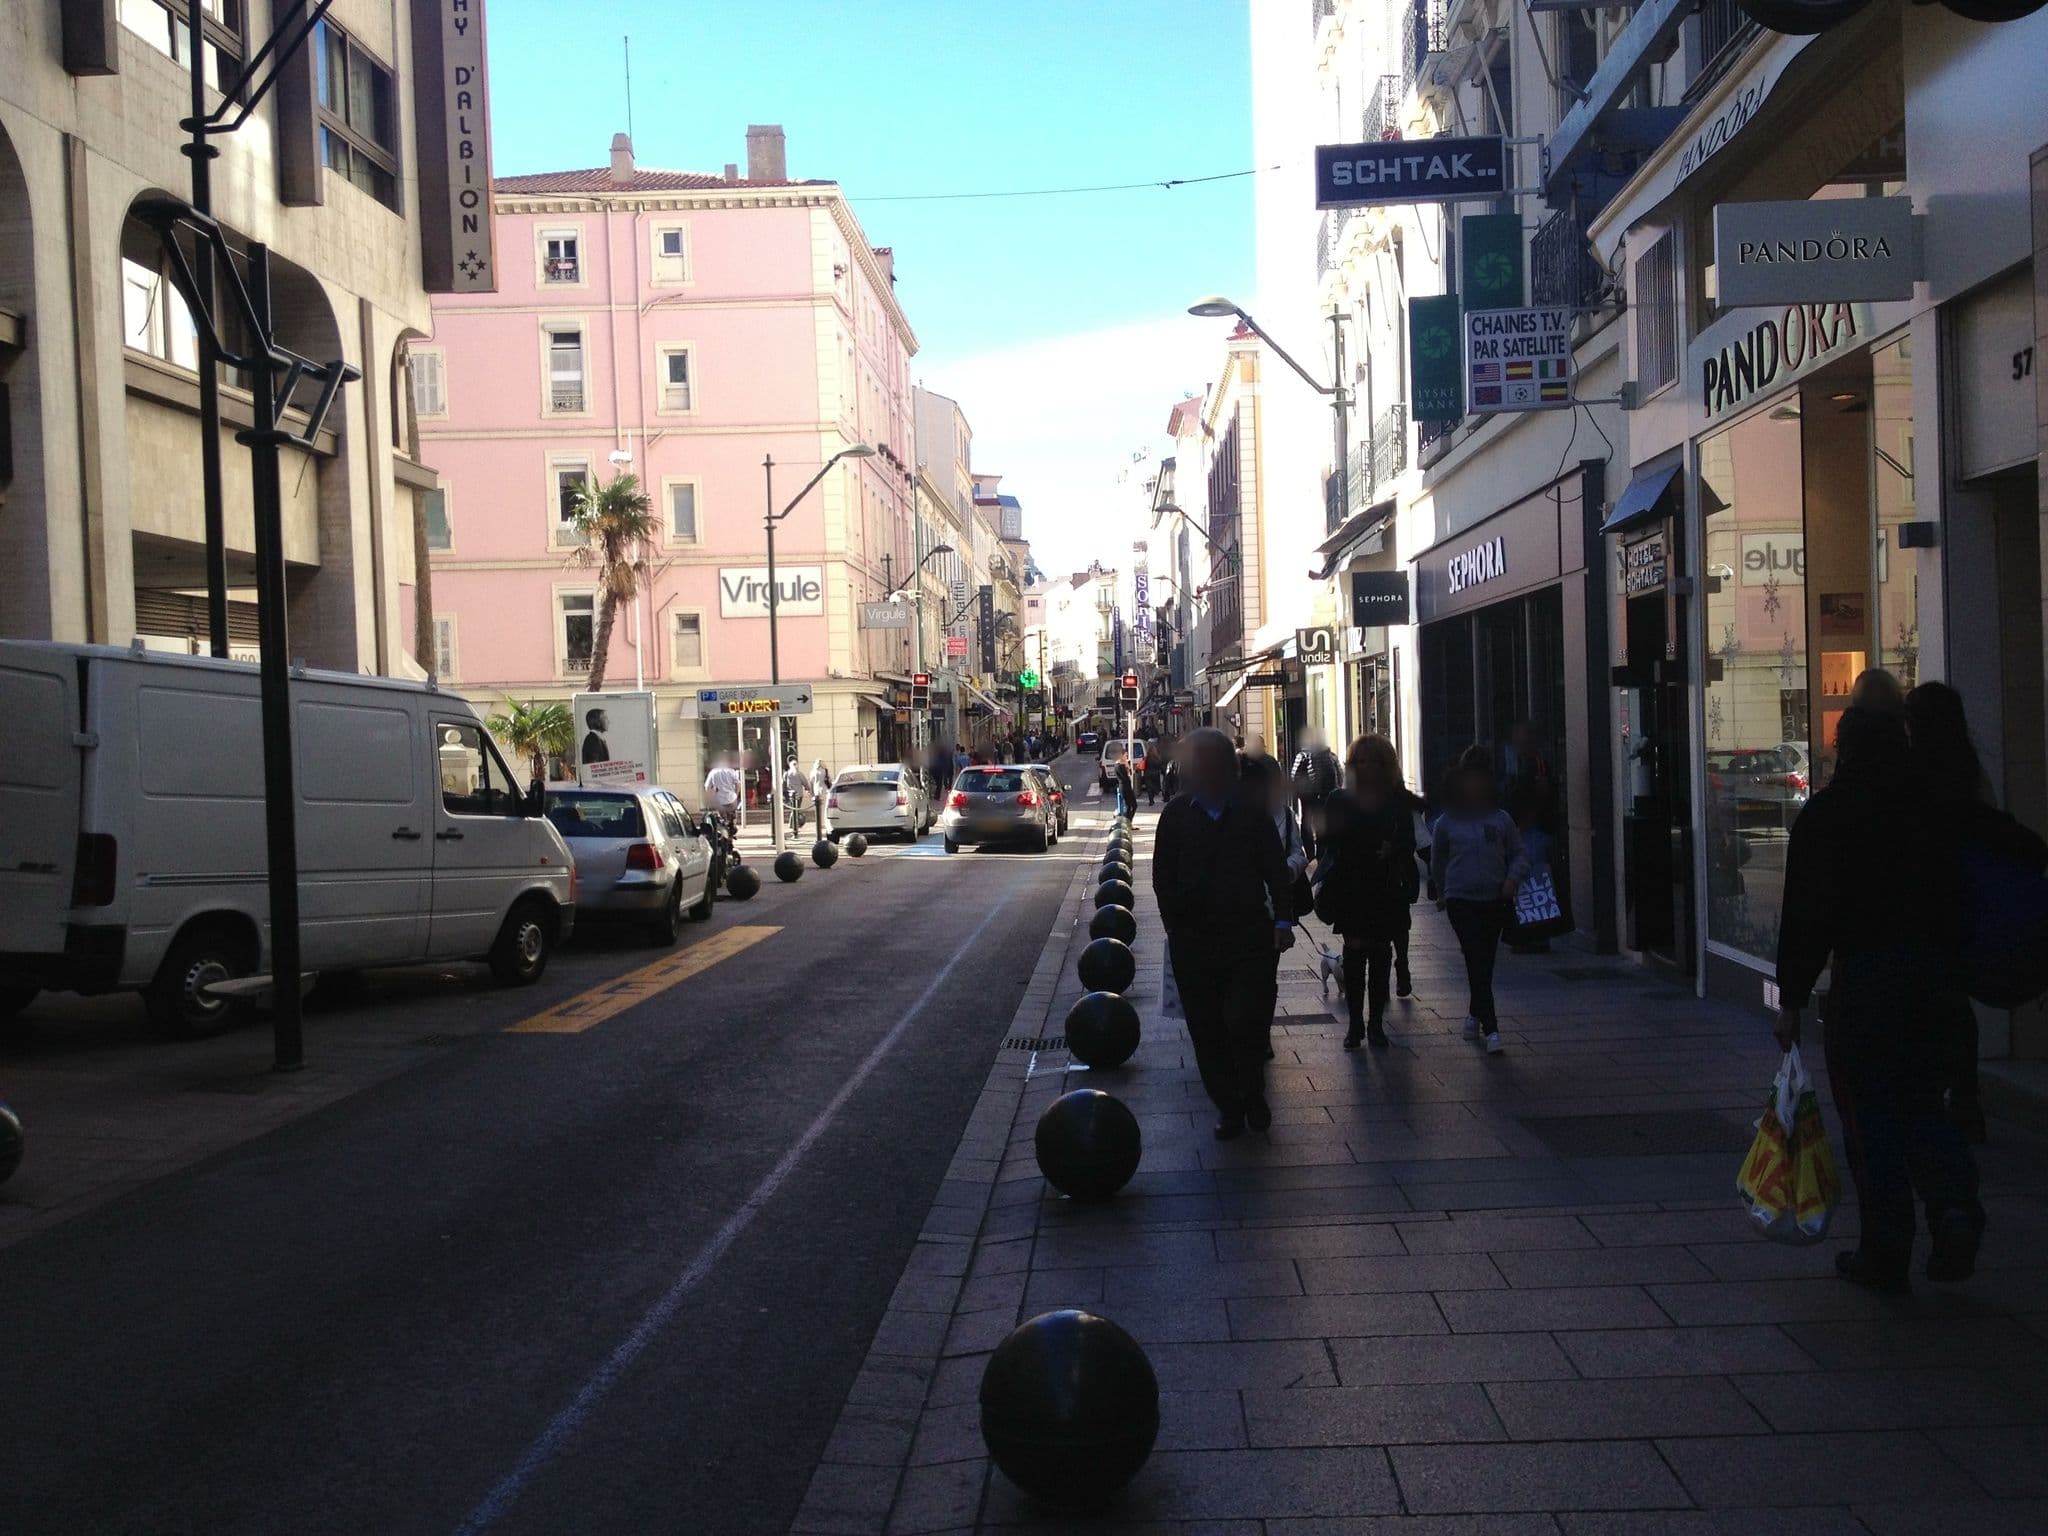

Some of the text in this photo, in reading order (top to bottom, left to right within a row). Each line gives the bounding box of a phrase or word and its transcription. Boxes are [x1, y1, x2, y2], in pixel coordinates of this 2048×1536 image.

[455, 66, 479, 233] D'ALBION
[1738, 235, 1892, 265] PANDORA
[1472, 311, 1566, 337] CHAINES T.V.
[1474, 335, 1566, 360] PAR SATELLITE
[2012, 347, 2034, 381] 57
[1448, 536, 1505, 594] SEPHORA
[721, 574, 821, 610] Virgule
[1359, 594, 1403, 604] SEPHORA
[867, 607, 906, 621] Virgule
[728, 699, 780, 714] OUVERT
